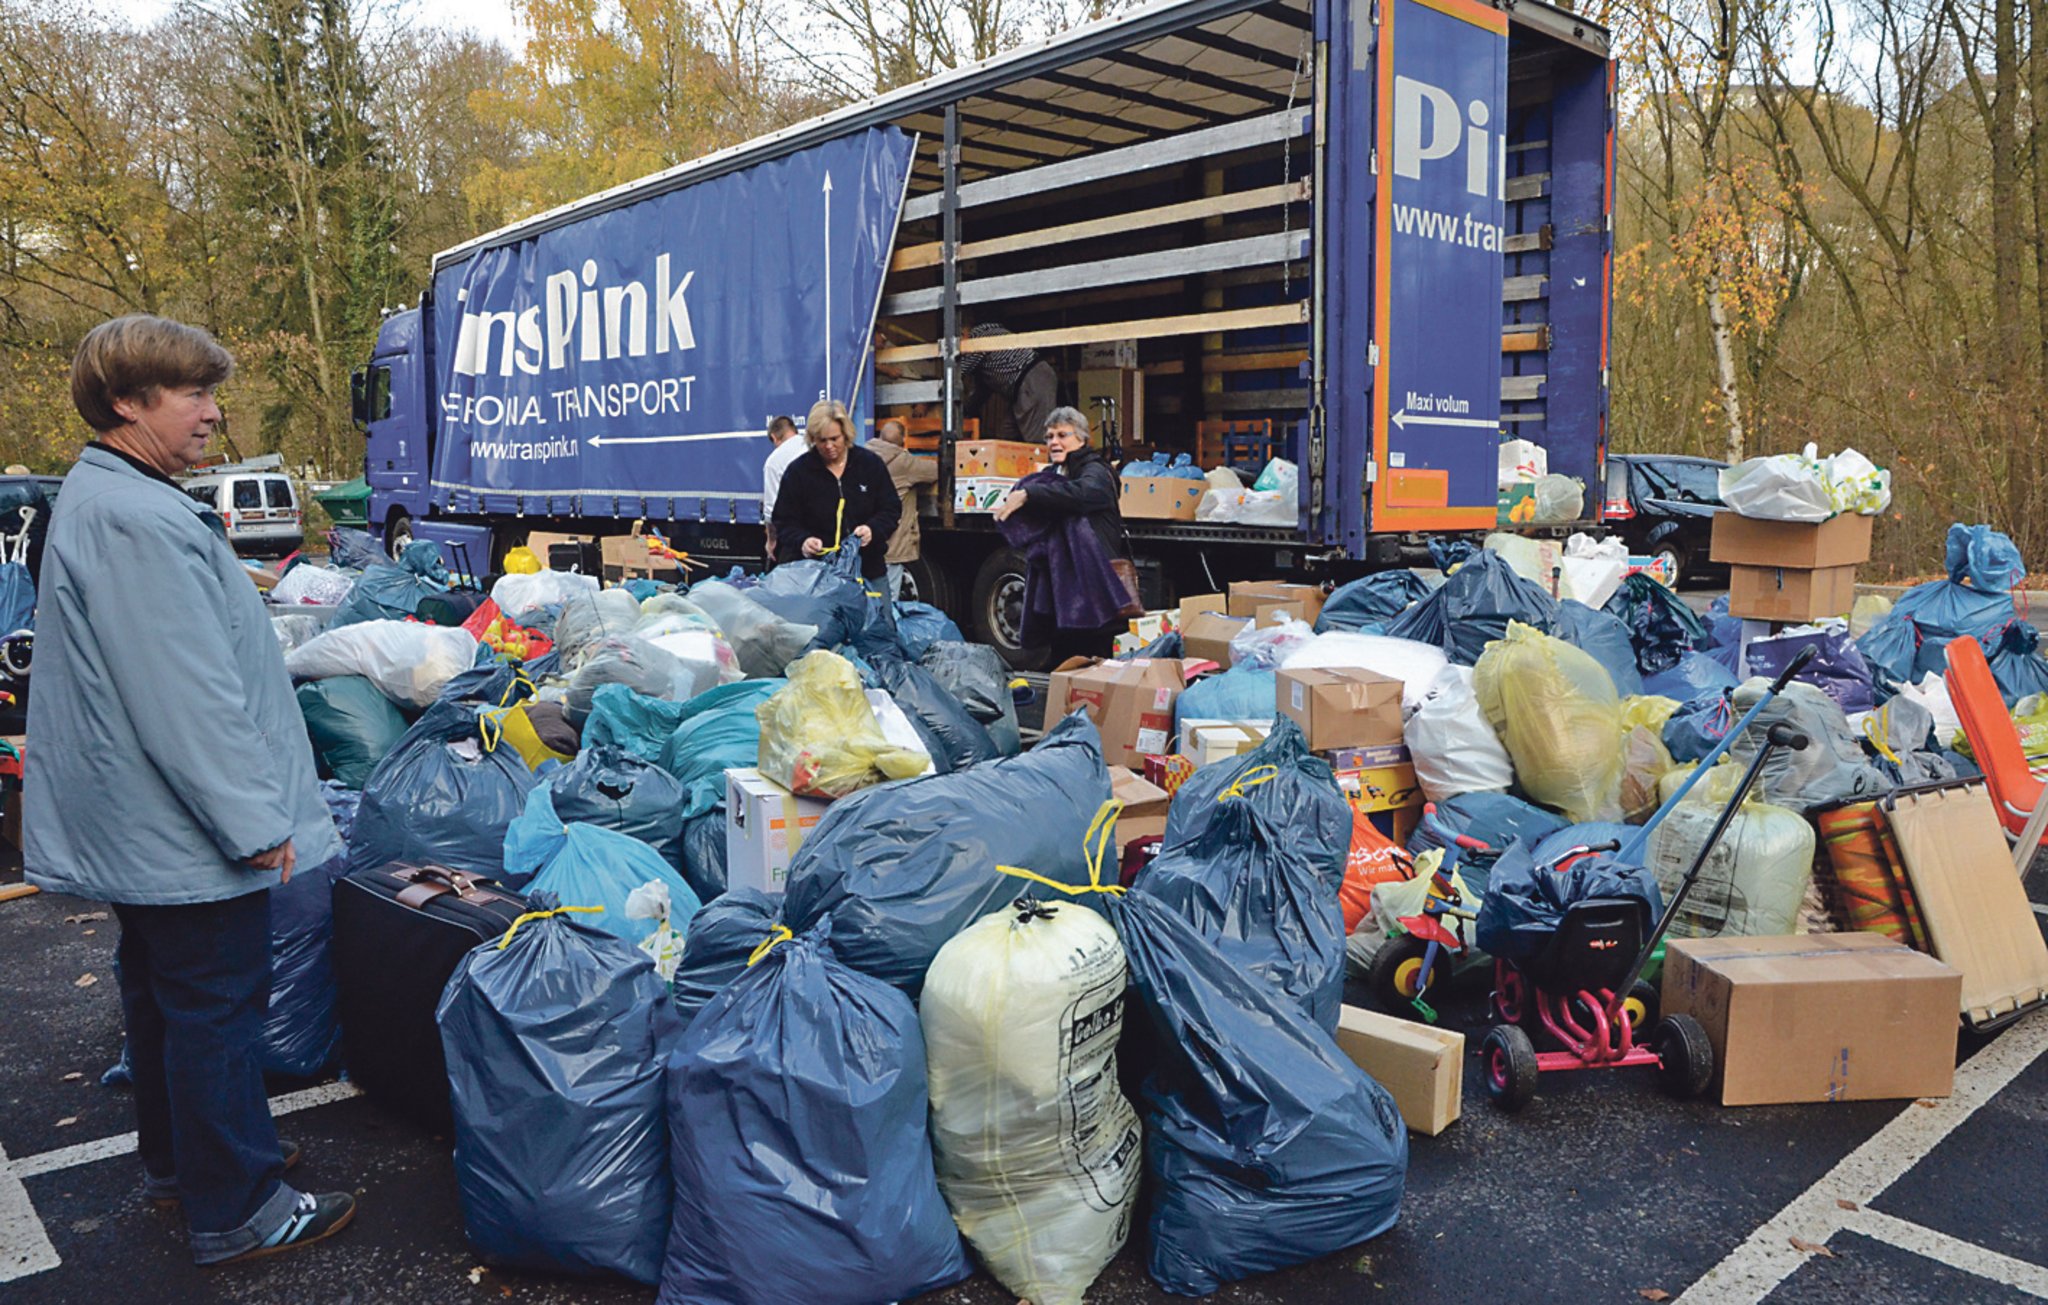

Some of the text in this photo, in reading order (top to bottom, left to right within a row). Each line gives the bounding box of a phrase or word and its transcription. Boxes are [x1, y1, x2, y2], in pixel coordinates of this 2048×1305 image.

[1394, 75, 1506, 200] Pi
[1407, 391, 1469, 413] Maxi volum
